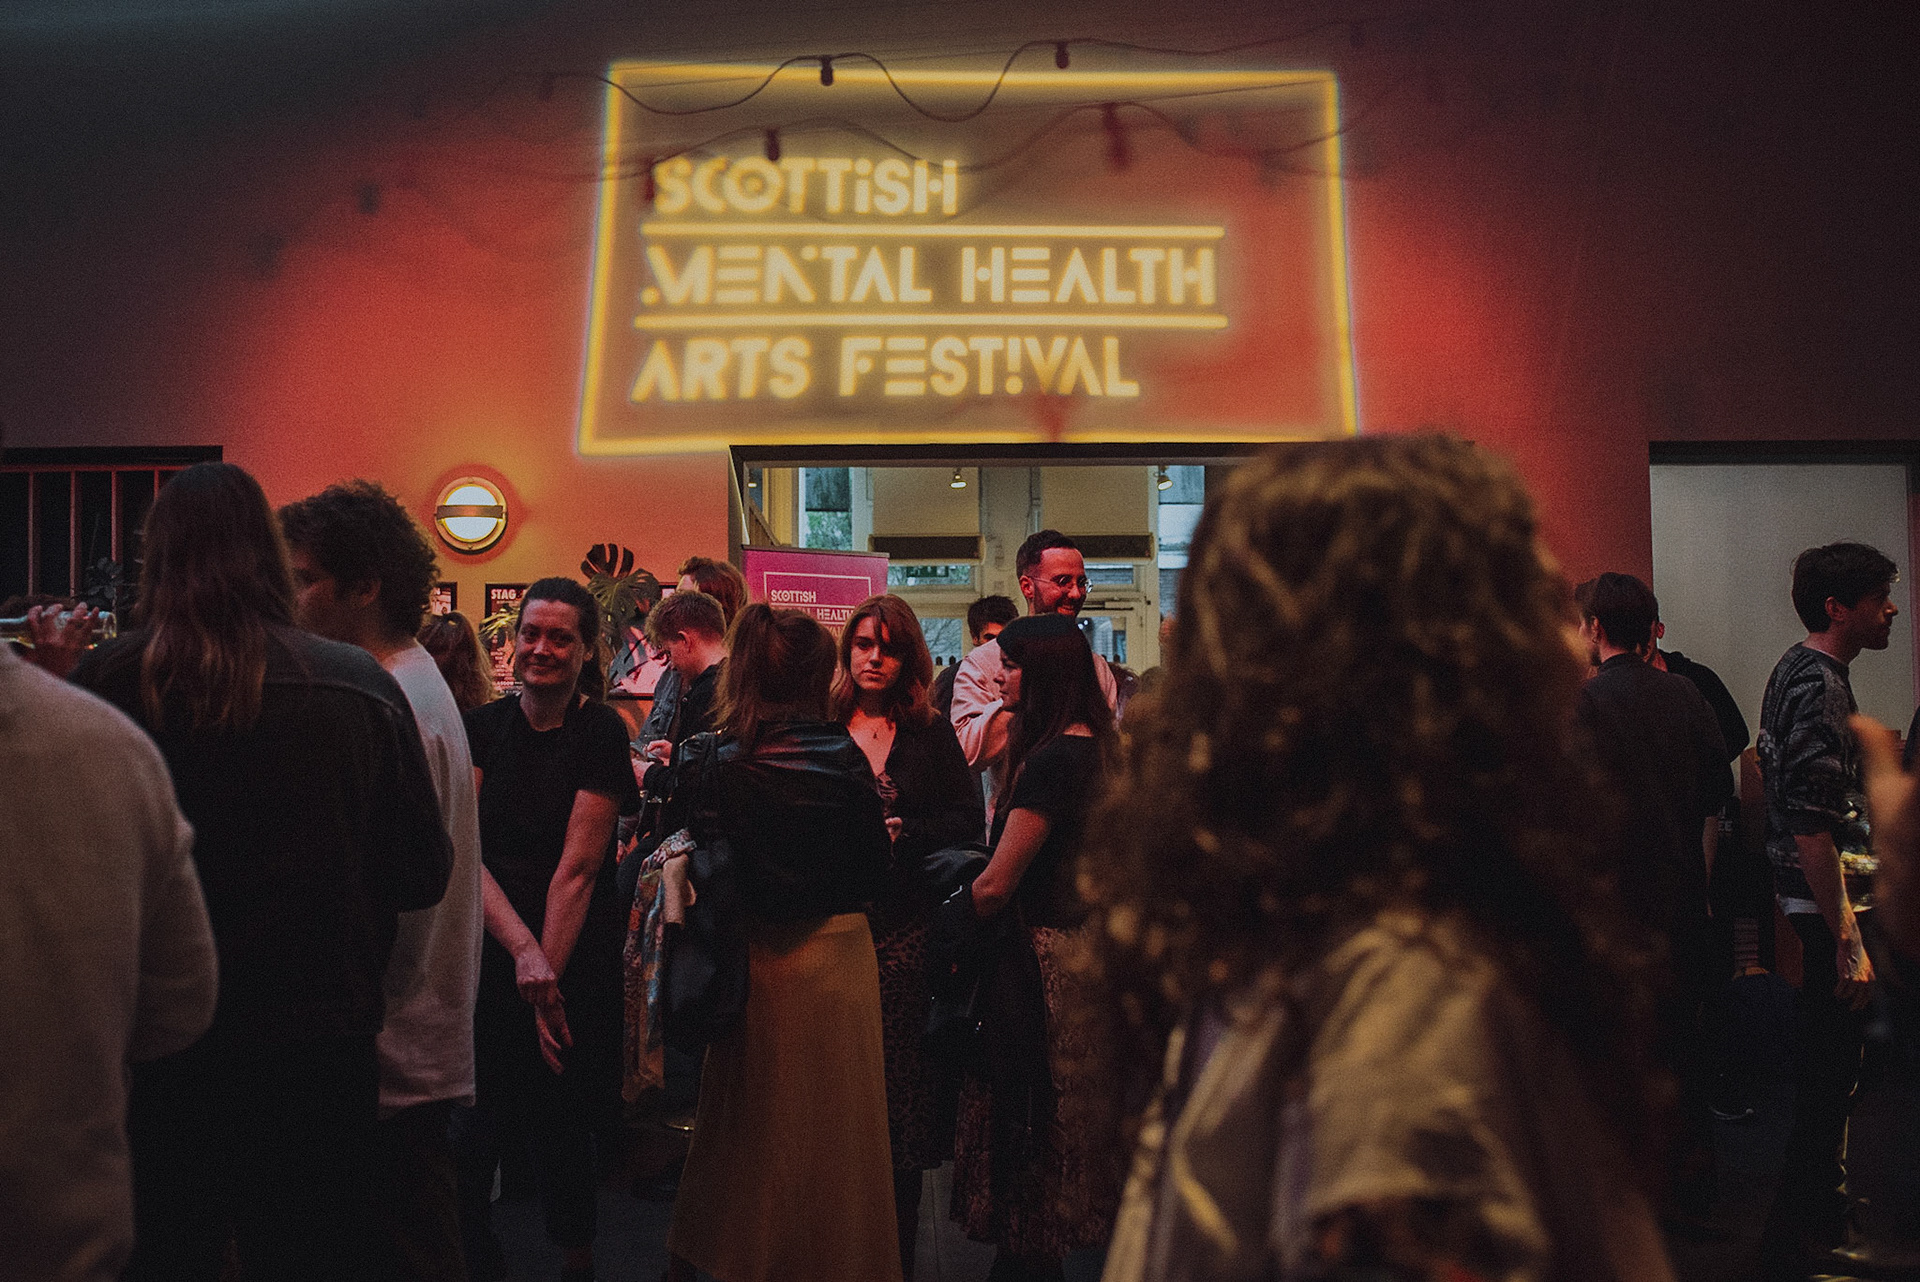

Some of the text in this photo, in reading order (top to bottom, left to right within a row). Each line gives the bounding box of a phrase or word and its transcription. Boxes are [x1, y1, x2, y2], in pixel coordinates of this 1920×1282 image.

[640, 245, 1216, 304] MENTAL HEALTH
[630, 336, 812, 401] ARTS
[491, 588, 517, 600] STAG
